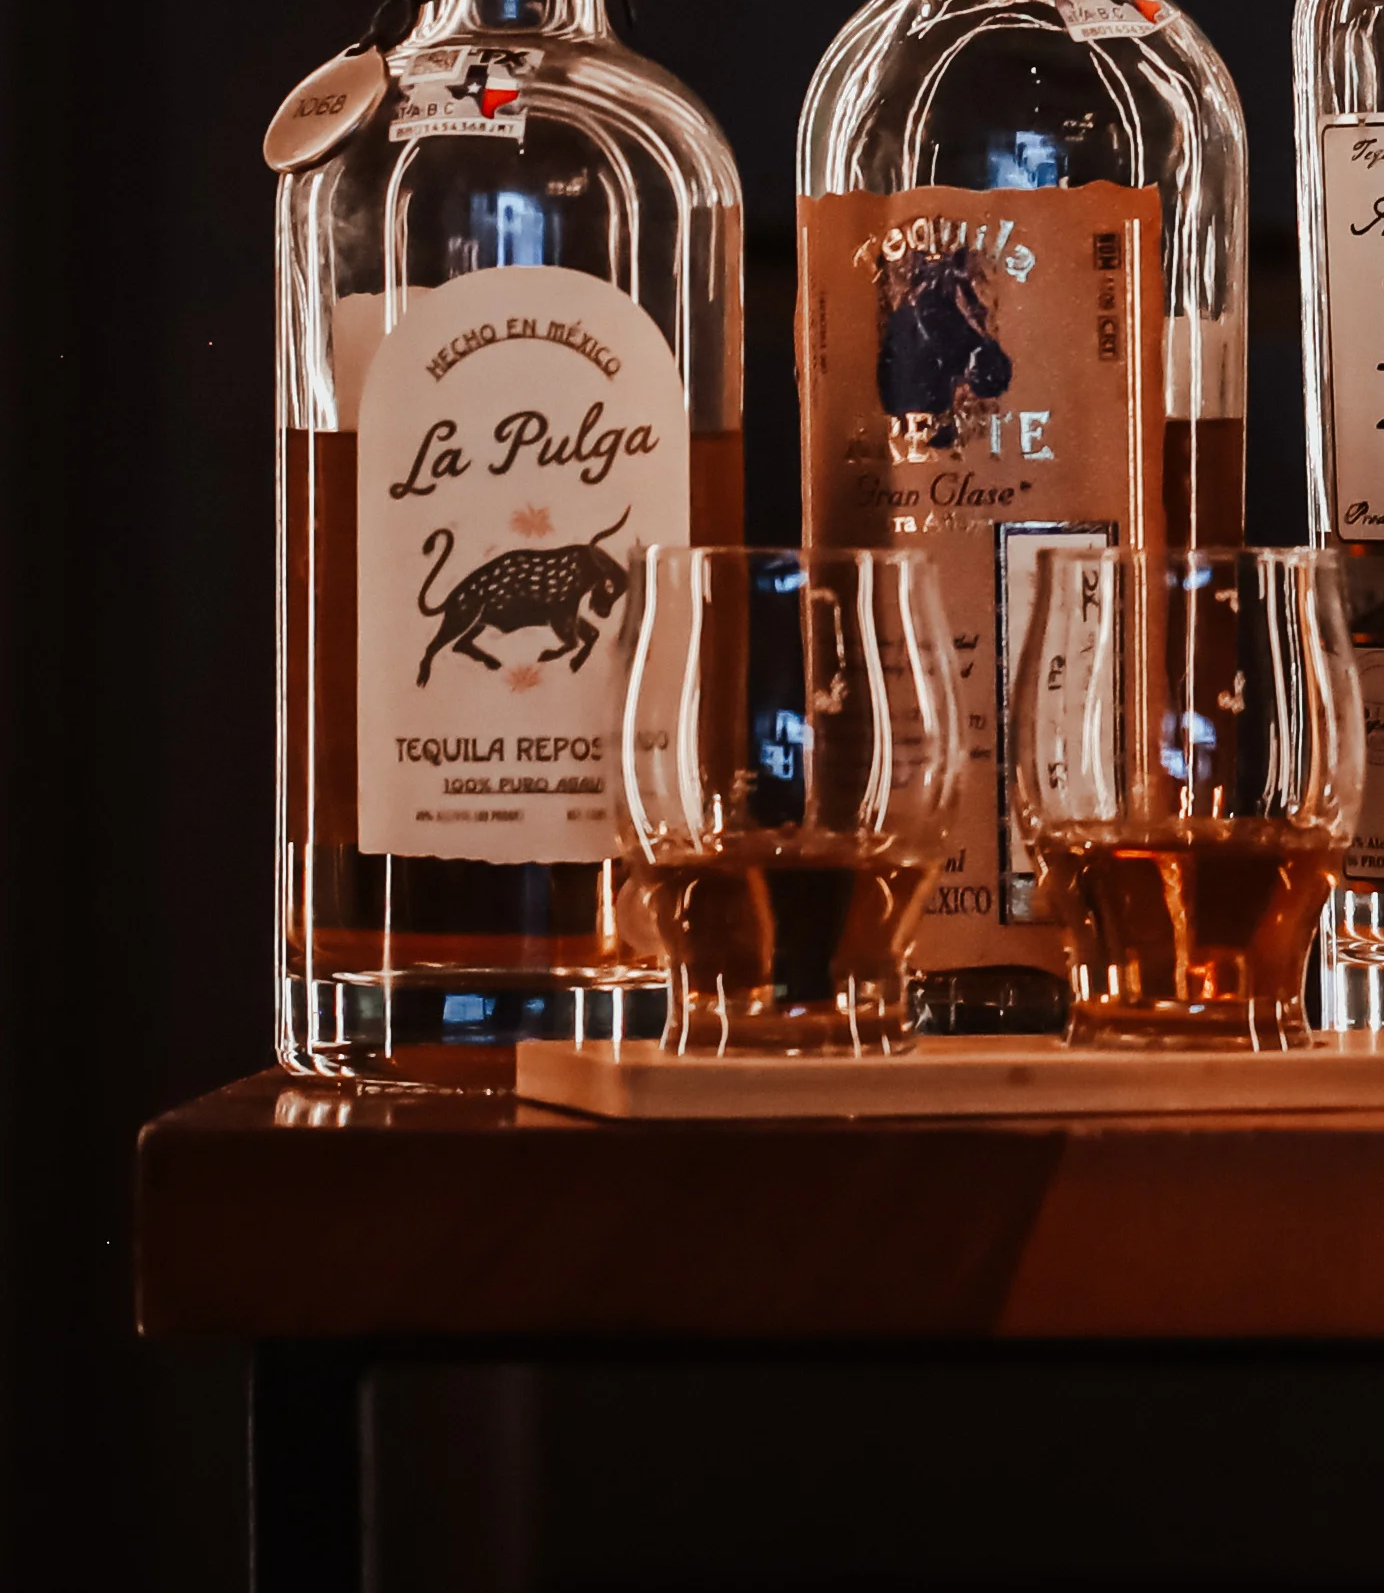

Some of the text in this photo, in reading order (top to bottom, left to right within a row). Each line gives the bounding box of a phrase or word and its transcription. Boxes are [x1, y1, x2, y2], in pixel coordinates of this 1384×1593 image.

[853, 216, 1037, 283] Tequila
[425, 323, 498, 383] HECHO
[506, 318, 538, 338] EN
[389, 401, 660, 500] La Pulga
[396, 737, 505, 766] TEQUILA
